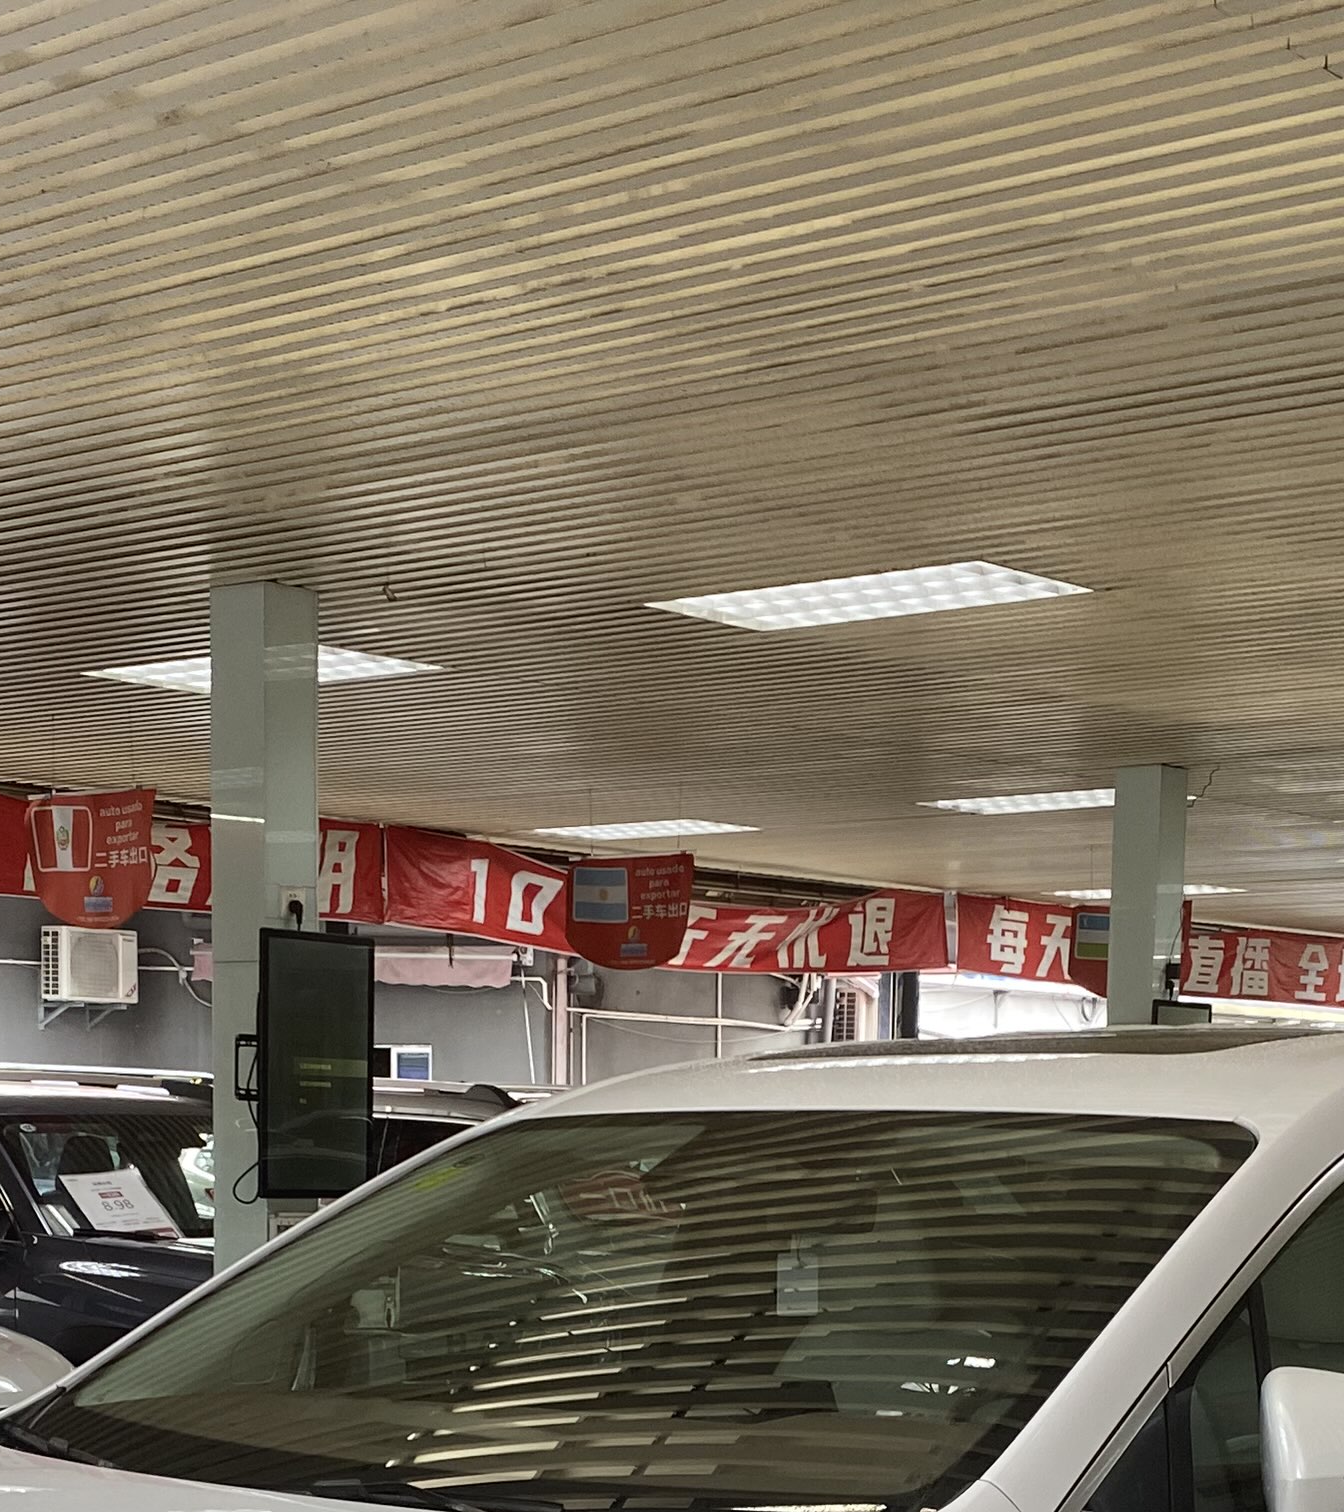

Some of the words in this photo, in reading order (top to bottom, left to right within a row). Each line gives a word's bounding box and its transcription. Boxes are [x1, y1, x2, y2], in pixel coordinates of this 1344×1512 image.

[99, 807, 120, 817] auto
[115, 819, 133, 832] para
[106, 831, 139, 846] exportar
[94, 846, 148, 869] 二手车出口
[635, 866, 656, 877] auto
[657, 864, 685, 875] usado
[649, 880, 670, 889] para
[640, 889, 681, 901] exportar
[631, 902, 688, 920] 二手车出口
[986, 904, 1074, 981] 每天
[1183, 936, 1272, 997] 直播
[102, 1199, 135, 1212] 8.98
